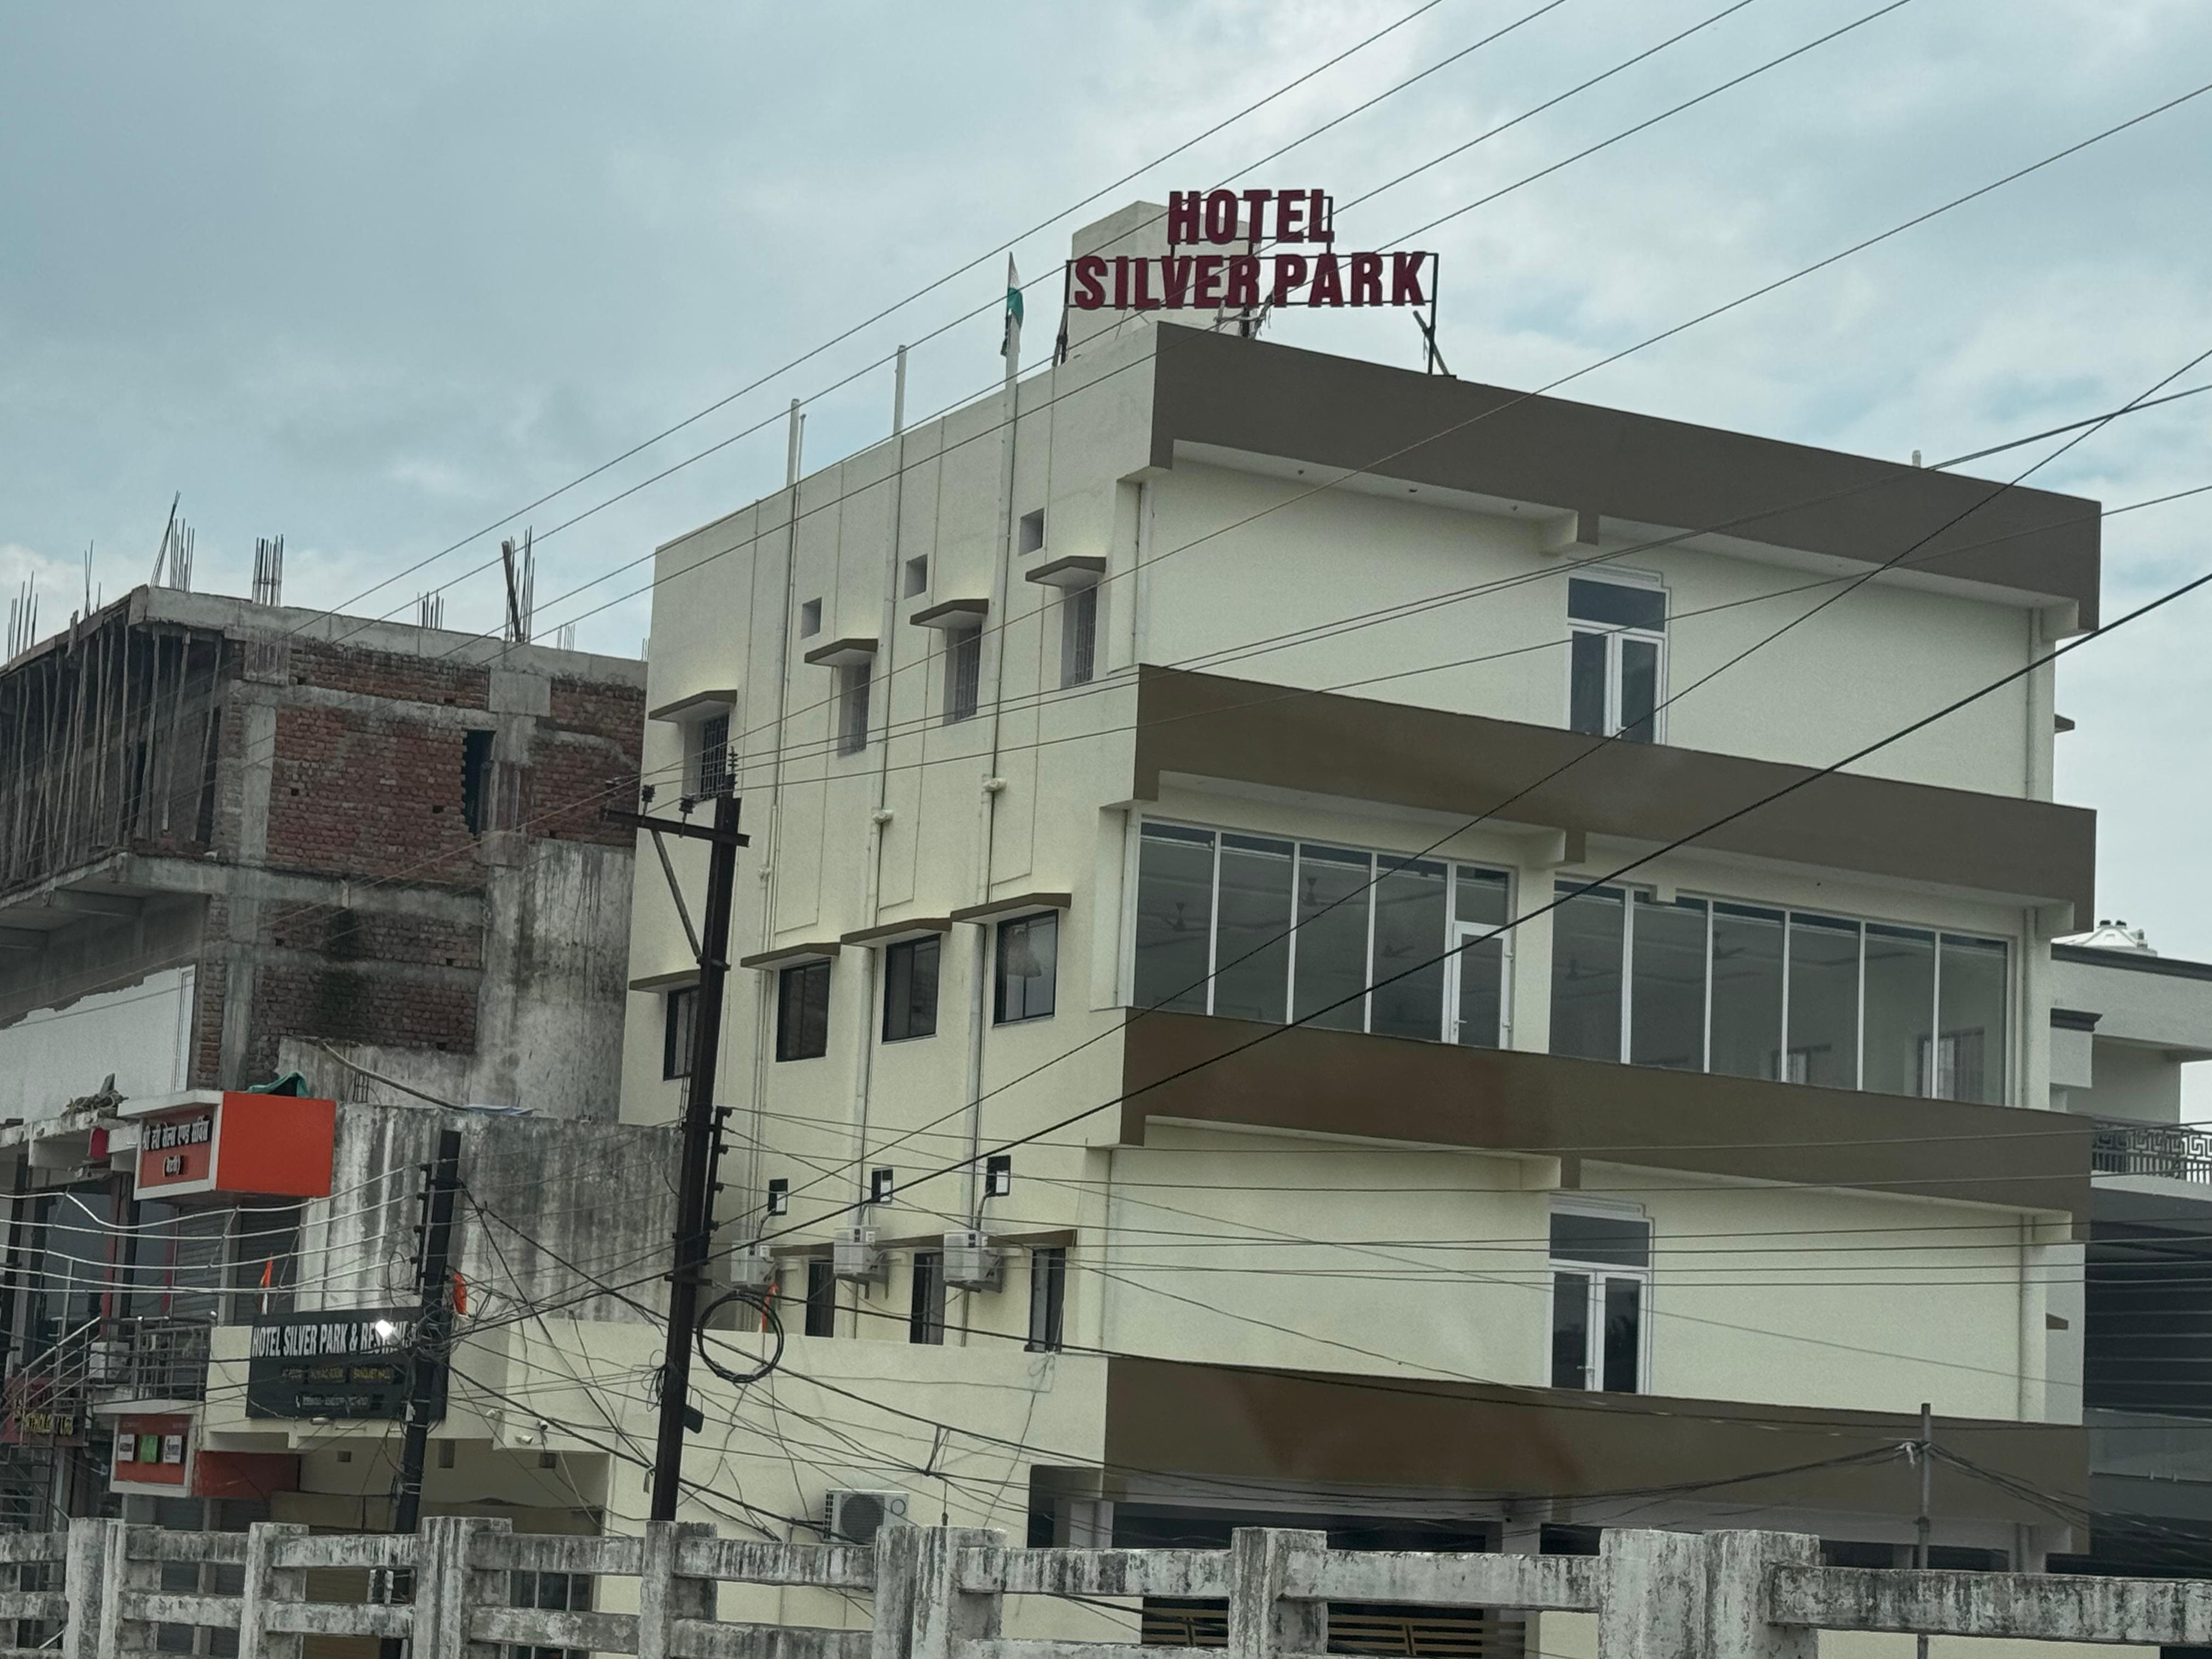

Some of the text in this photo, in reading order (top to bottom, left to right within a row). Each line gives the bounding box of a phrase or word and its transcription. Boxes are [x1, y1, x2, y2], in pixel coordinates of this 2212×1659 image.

[1167, 189, 1335, 245] HOTEL
[1074, 251, 1426, 311] SILVER PARK
[252, 1325, 281, 1357] HOTEL
[283, 1324, 318, 1357] SILVER
[319, 1323, 349, 1355] PARK
[349, 1322, 358, 1352] &
